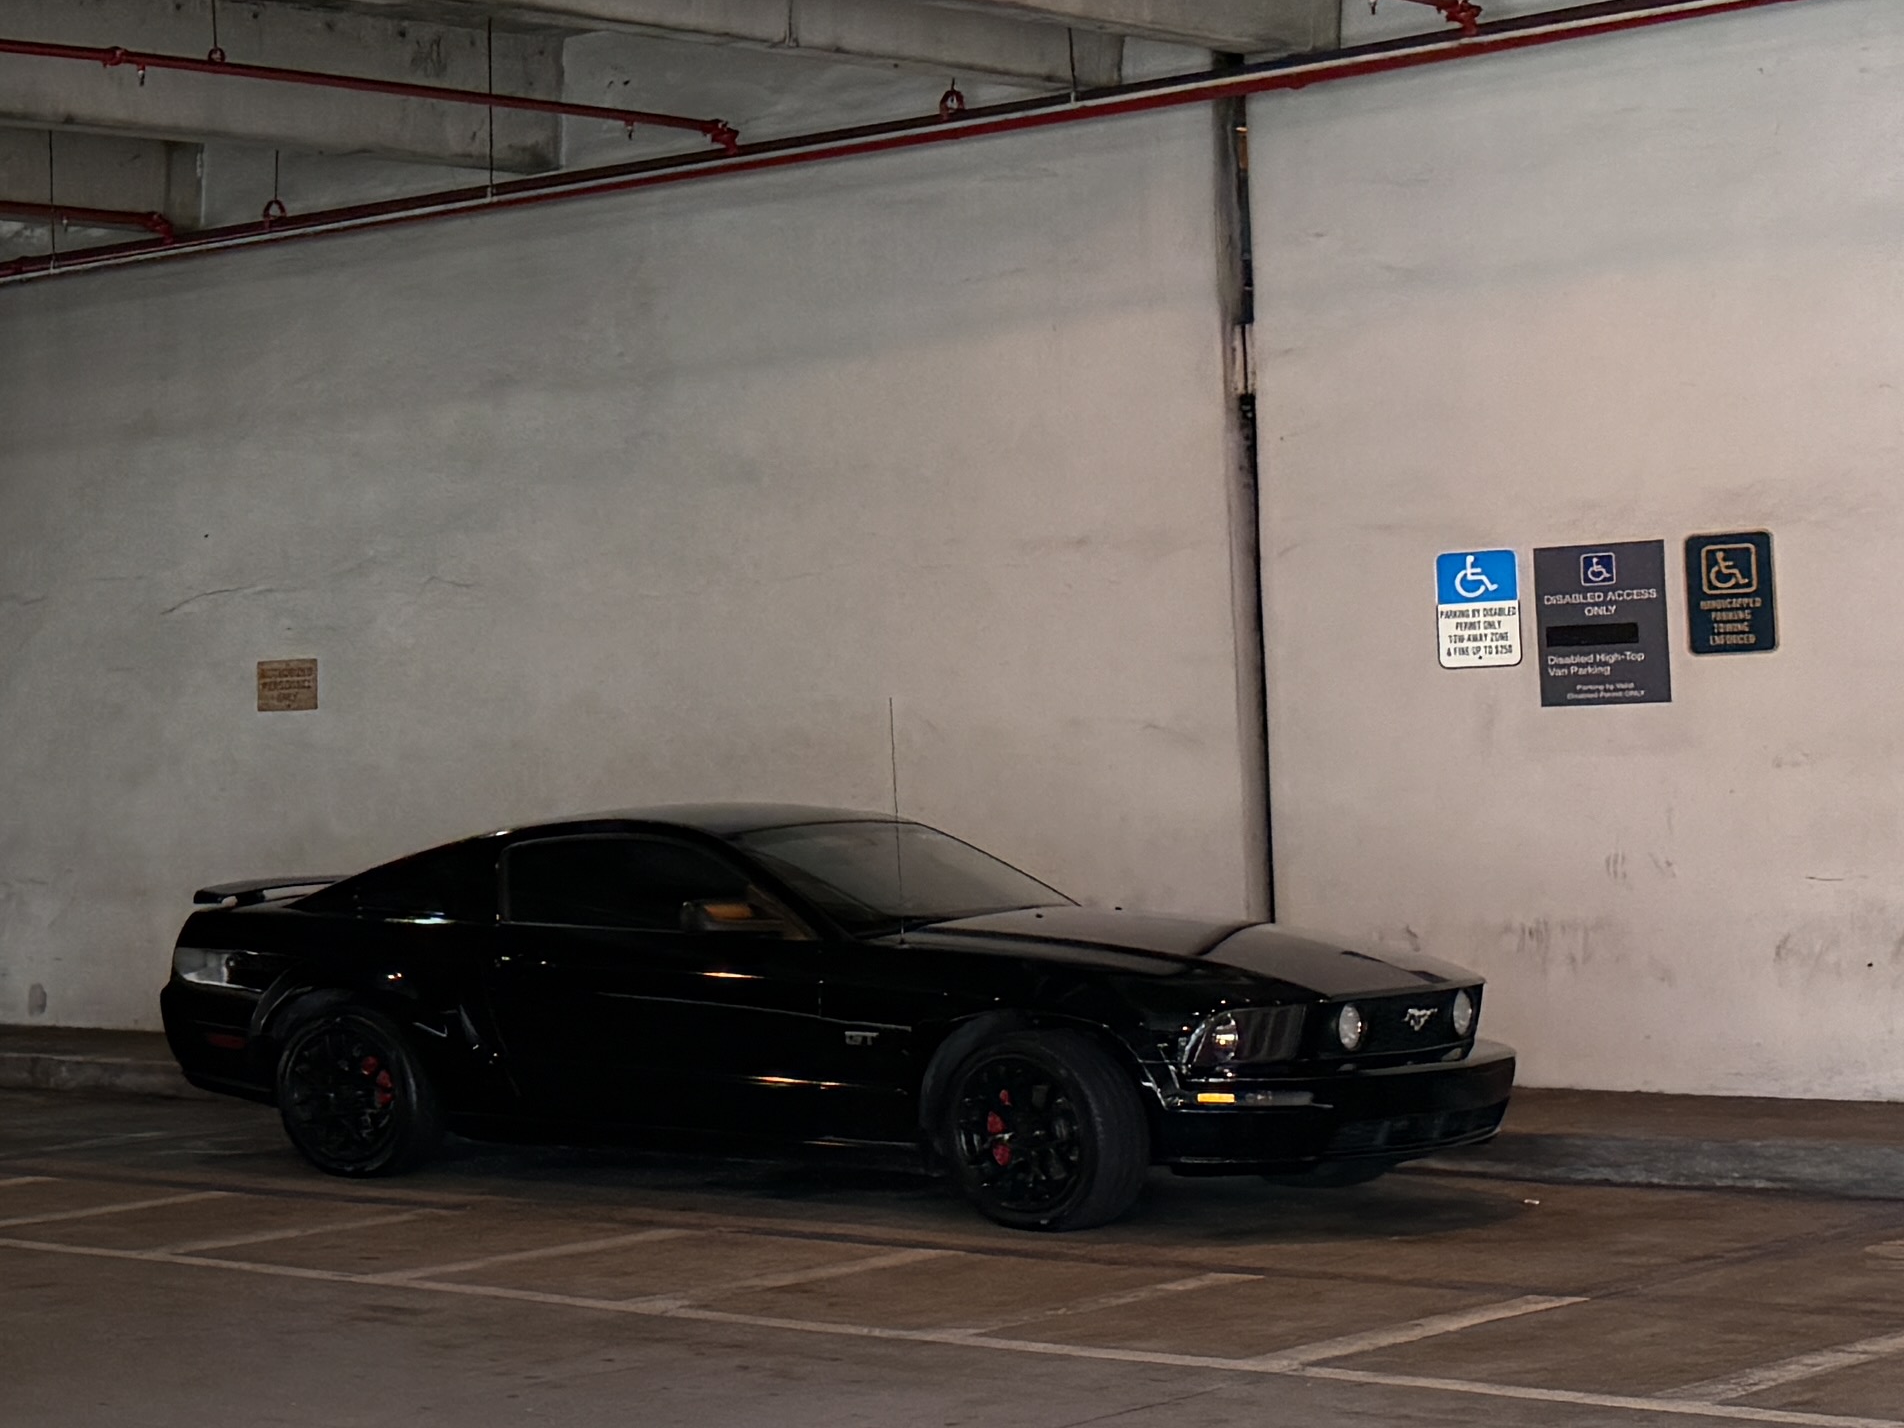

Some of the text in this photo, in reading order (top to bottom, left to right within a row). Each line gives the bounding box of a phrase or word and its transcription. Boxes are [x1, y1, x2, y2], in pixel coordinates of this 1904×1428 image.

[1544, 589, 1657, 604] DISABLED ACCESS
[1483, 606, 1516, 617] DISABLED
[1584, 605, 1616, 616] ONLY
[1548, 652, 1645, 665] Disabled High-Top
[1548, 665, 1611, 676] Van Parking
